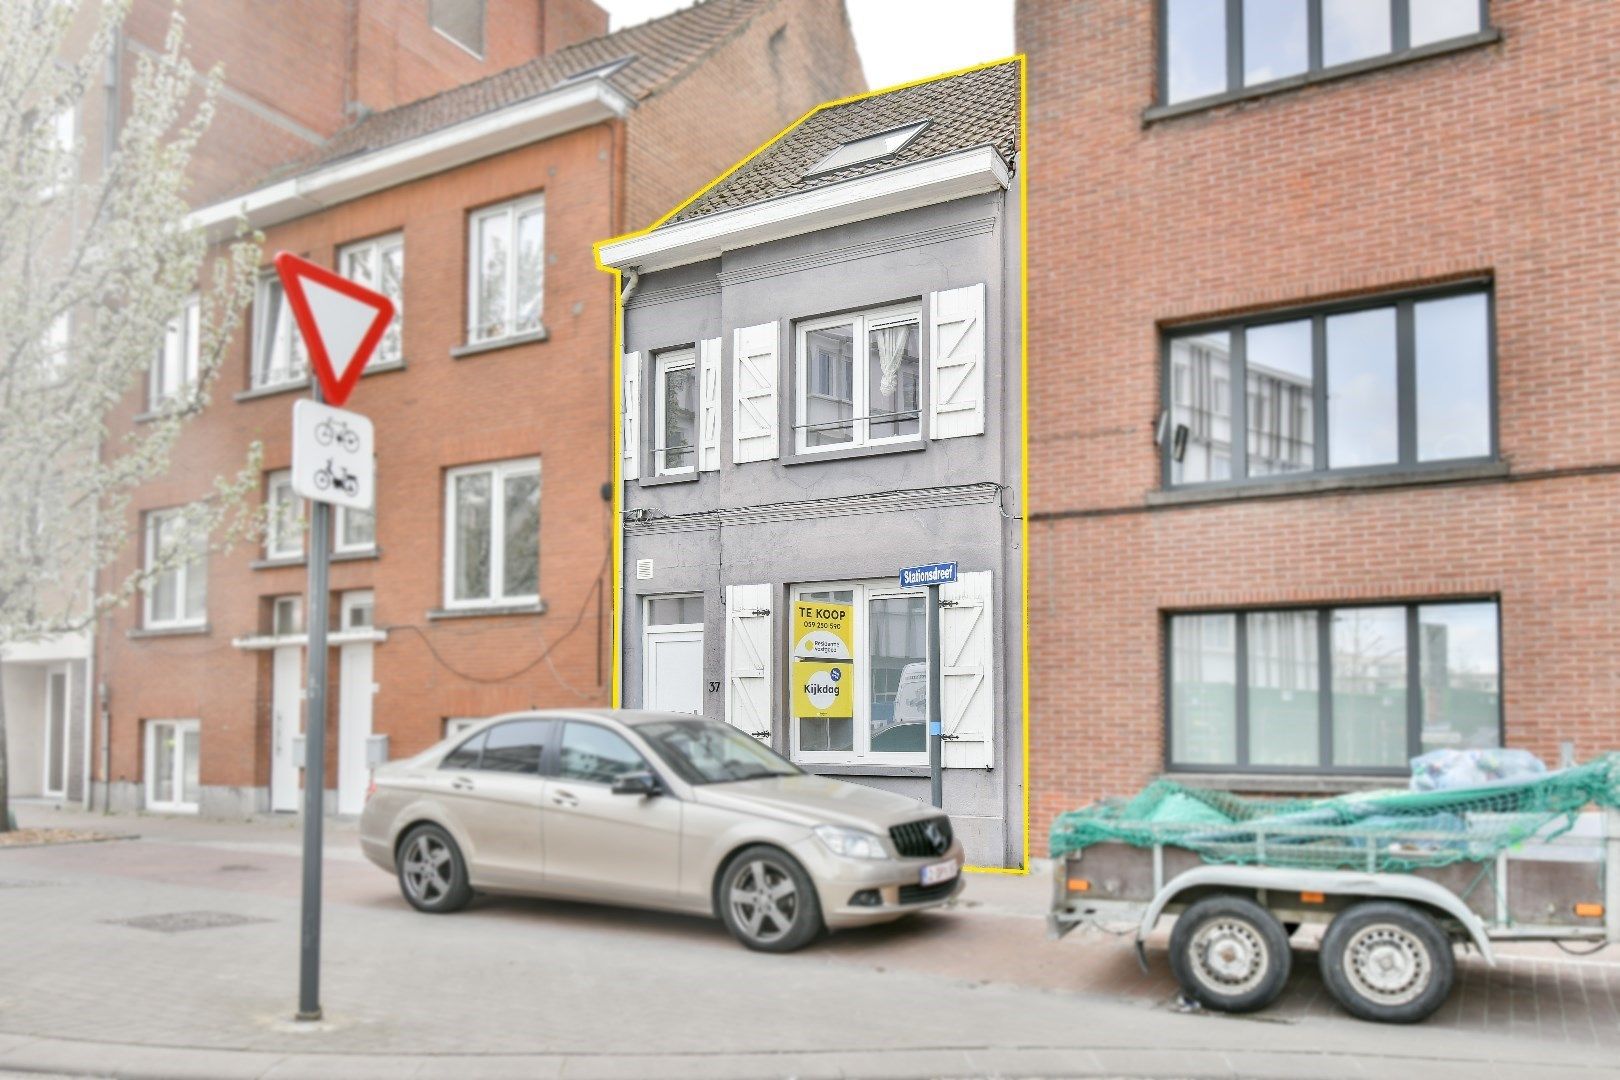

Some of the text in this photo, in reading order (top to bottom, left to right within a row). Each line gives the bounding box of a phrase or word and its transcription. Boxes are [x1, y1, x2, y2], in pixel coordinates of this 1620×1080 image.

[904, 564, 953, 584] Stationsdreef
[799, 607, 846, 620] TE KOOP
[709, 682, 721, 693] 37
[804, 684, 840, 696] Kijkdag
